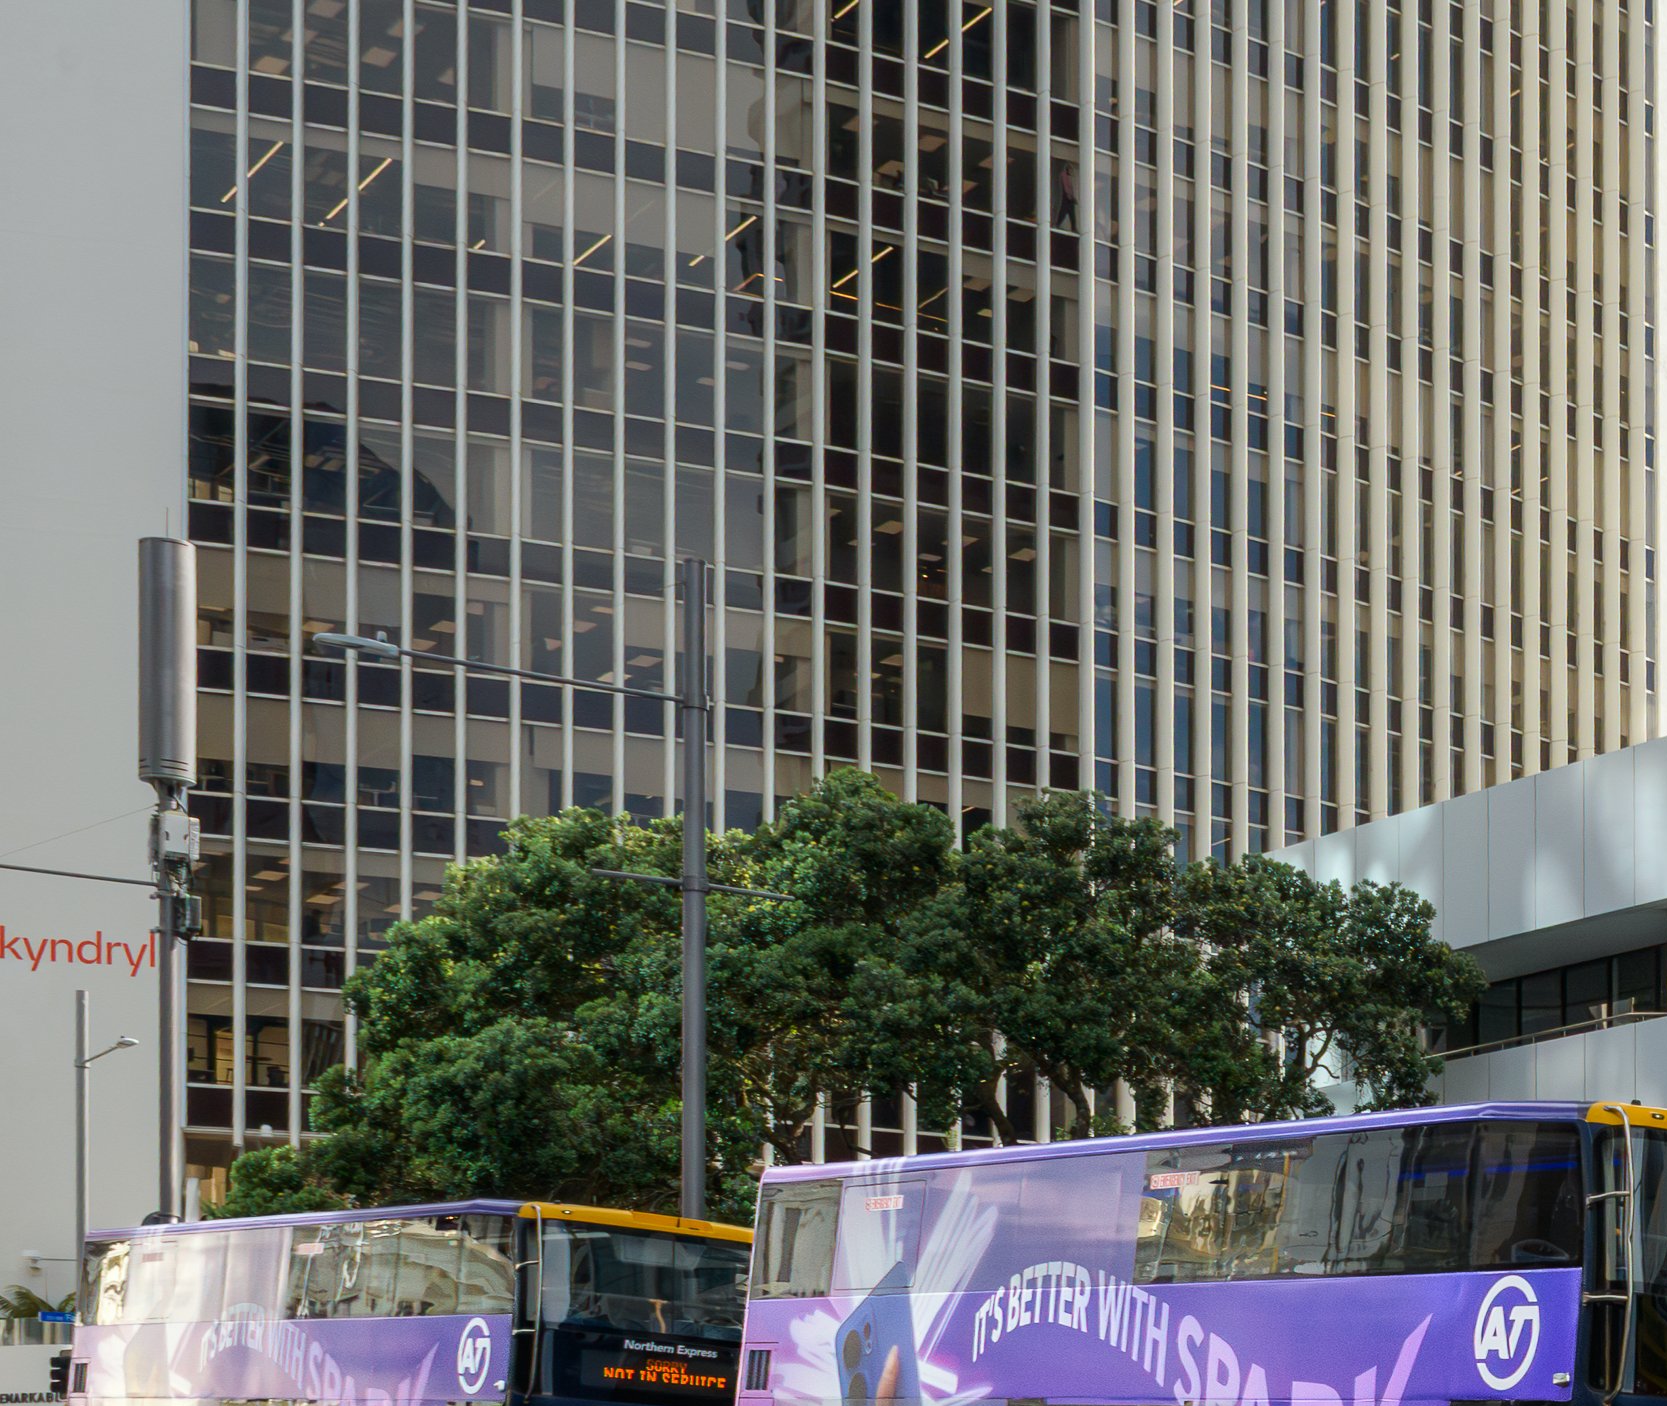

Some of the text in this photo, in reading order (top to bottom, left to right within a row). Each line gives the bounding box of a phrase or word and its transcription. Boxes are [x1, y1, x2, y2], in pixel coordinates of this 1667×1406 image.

[0, 925, 156, 977] kyndryl
[623, 1339, 718, 1359] Northern Express
[972, 1285, 1005, 1363] IT'S
[1006, 1261, 1092, 1333] BETTER
[1098, 1269, 1171, 1388] WITH
